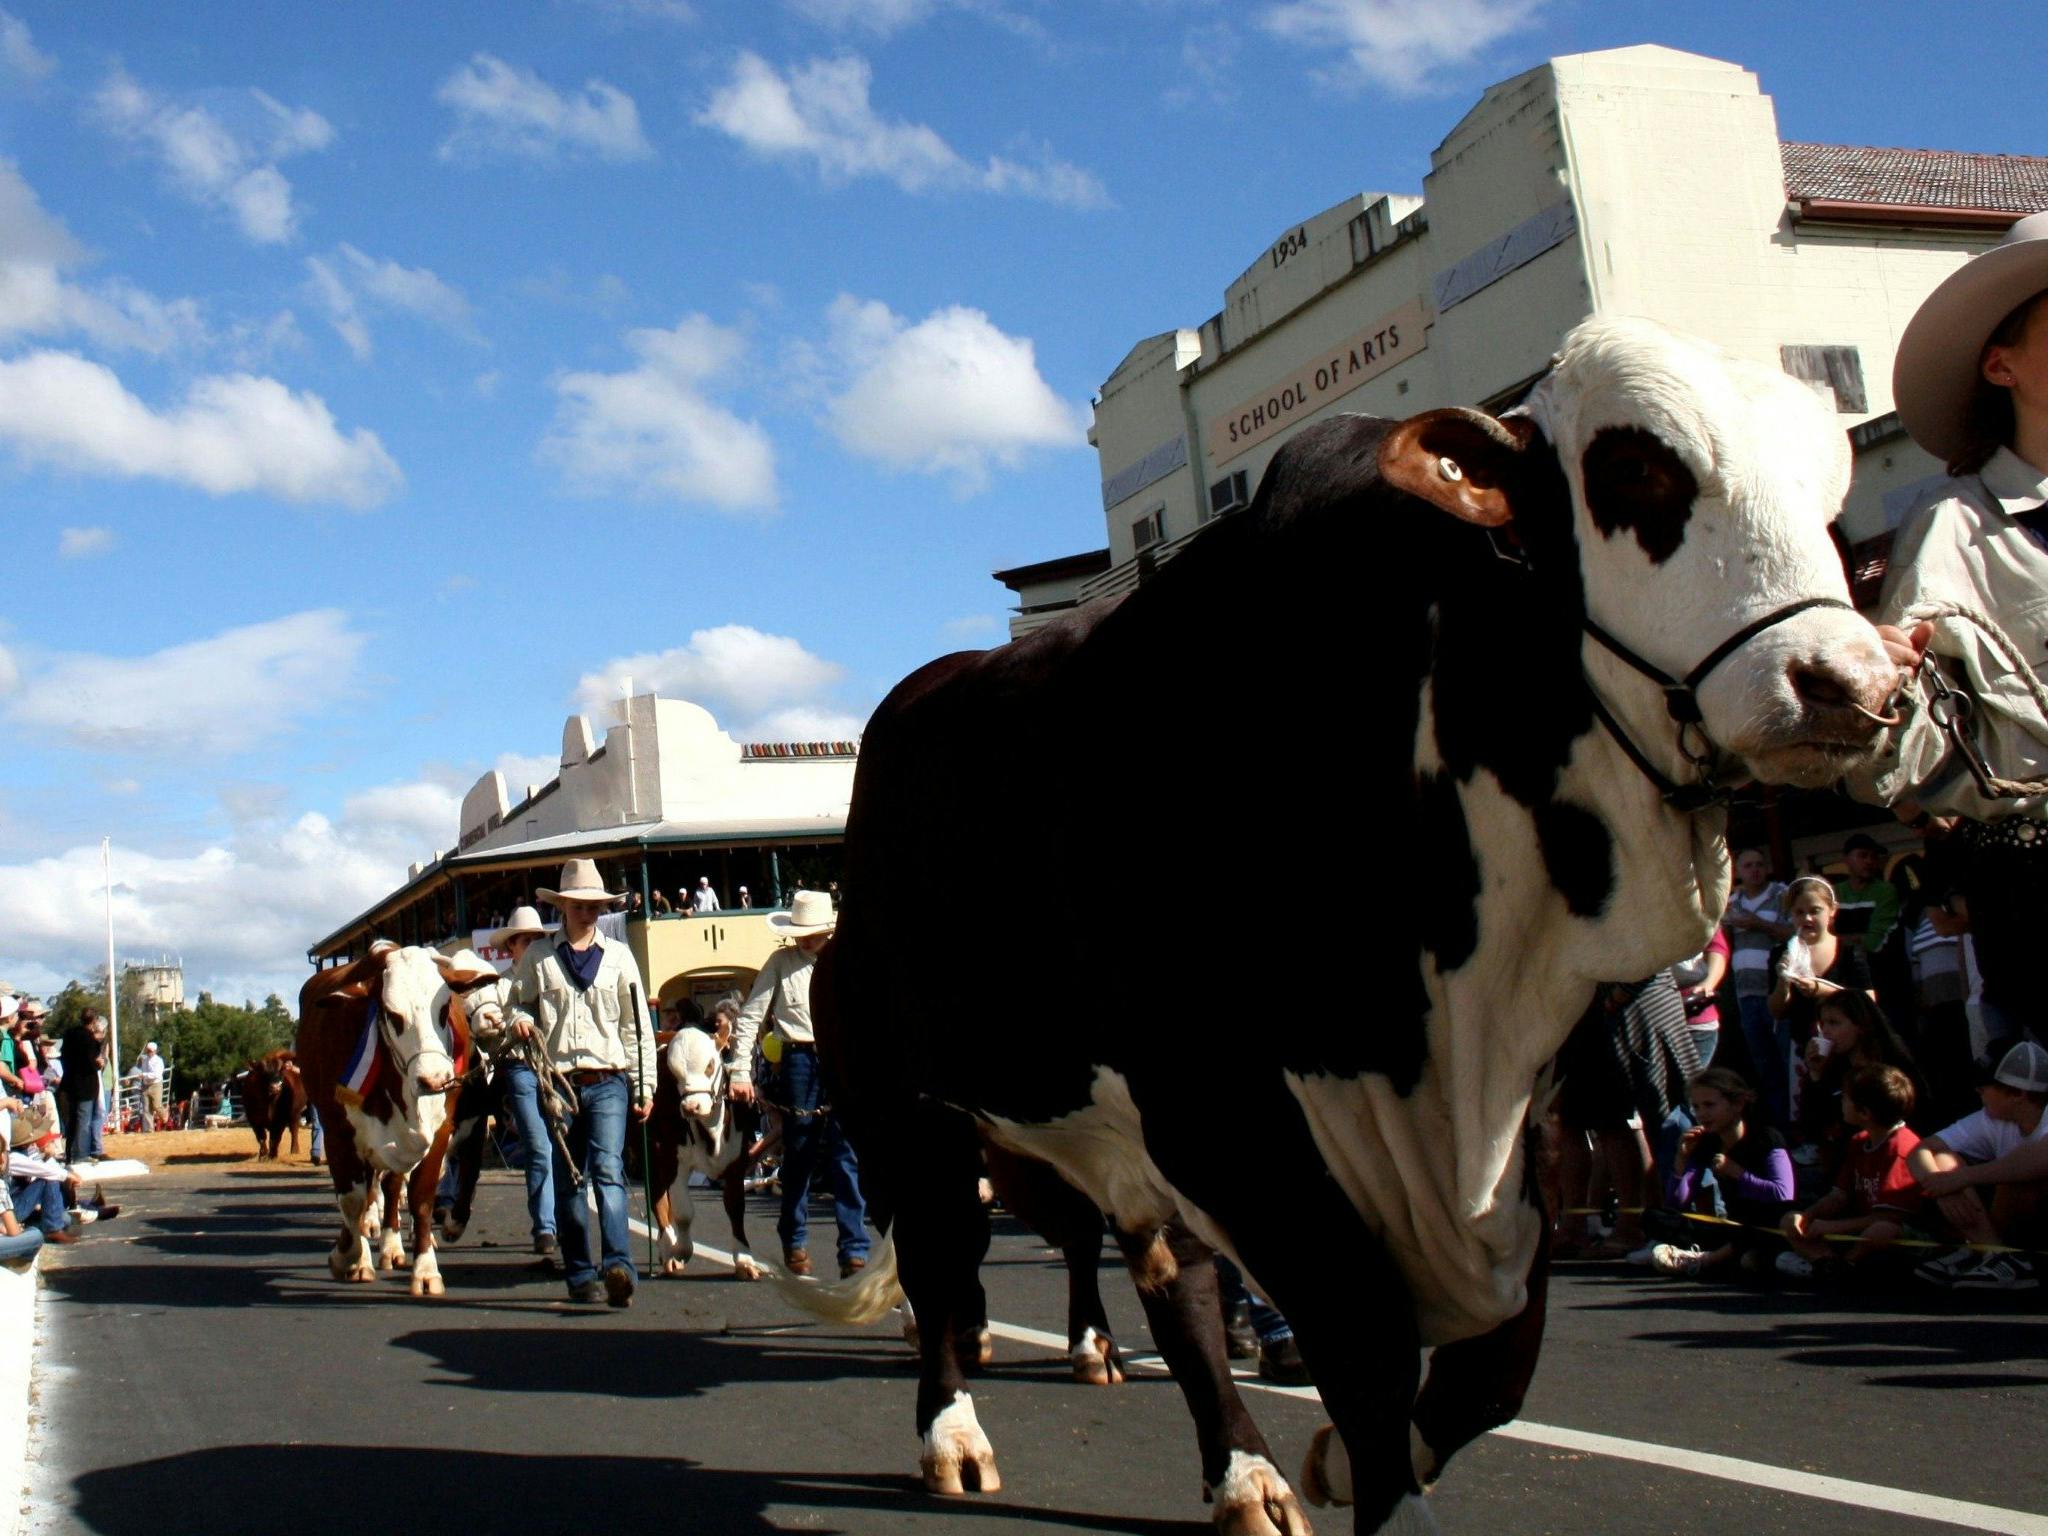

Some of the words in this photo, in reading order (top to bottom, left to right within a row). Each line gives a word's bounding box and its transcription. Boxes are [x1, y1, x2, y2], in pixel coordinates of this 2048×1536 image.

[1271, 227, 1308, 268] 1934
[1228, 382, 1306, 442] SCHOOL
[1315, 358, 1339, 391] OF
[1349, 324, 1400, 375] ARTS
